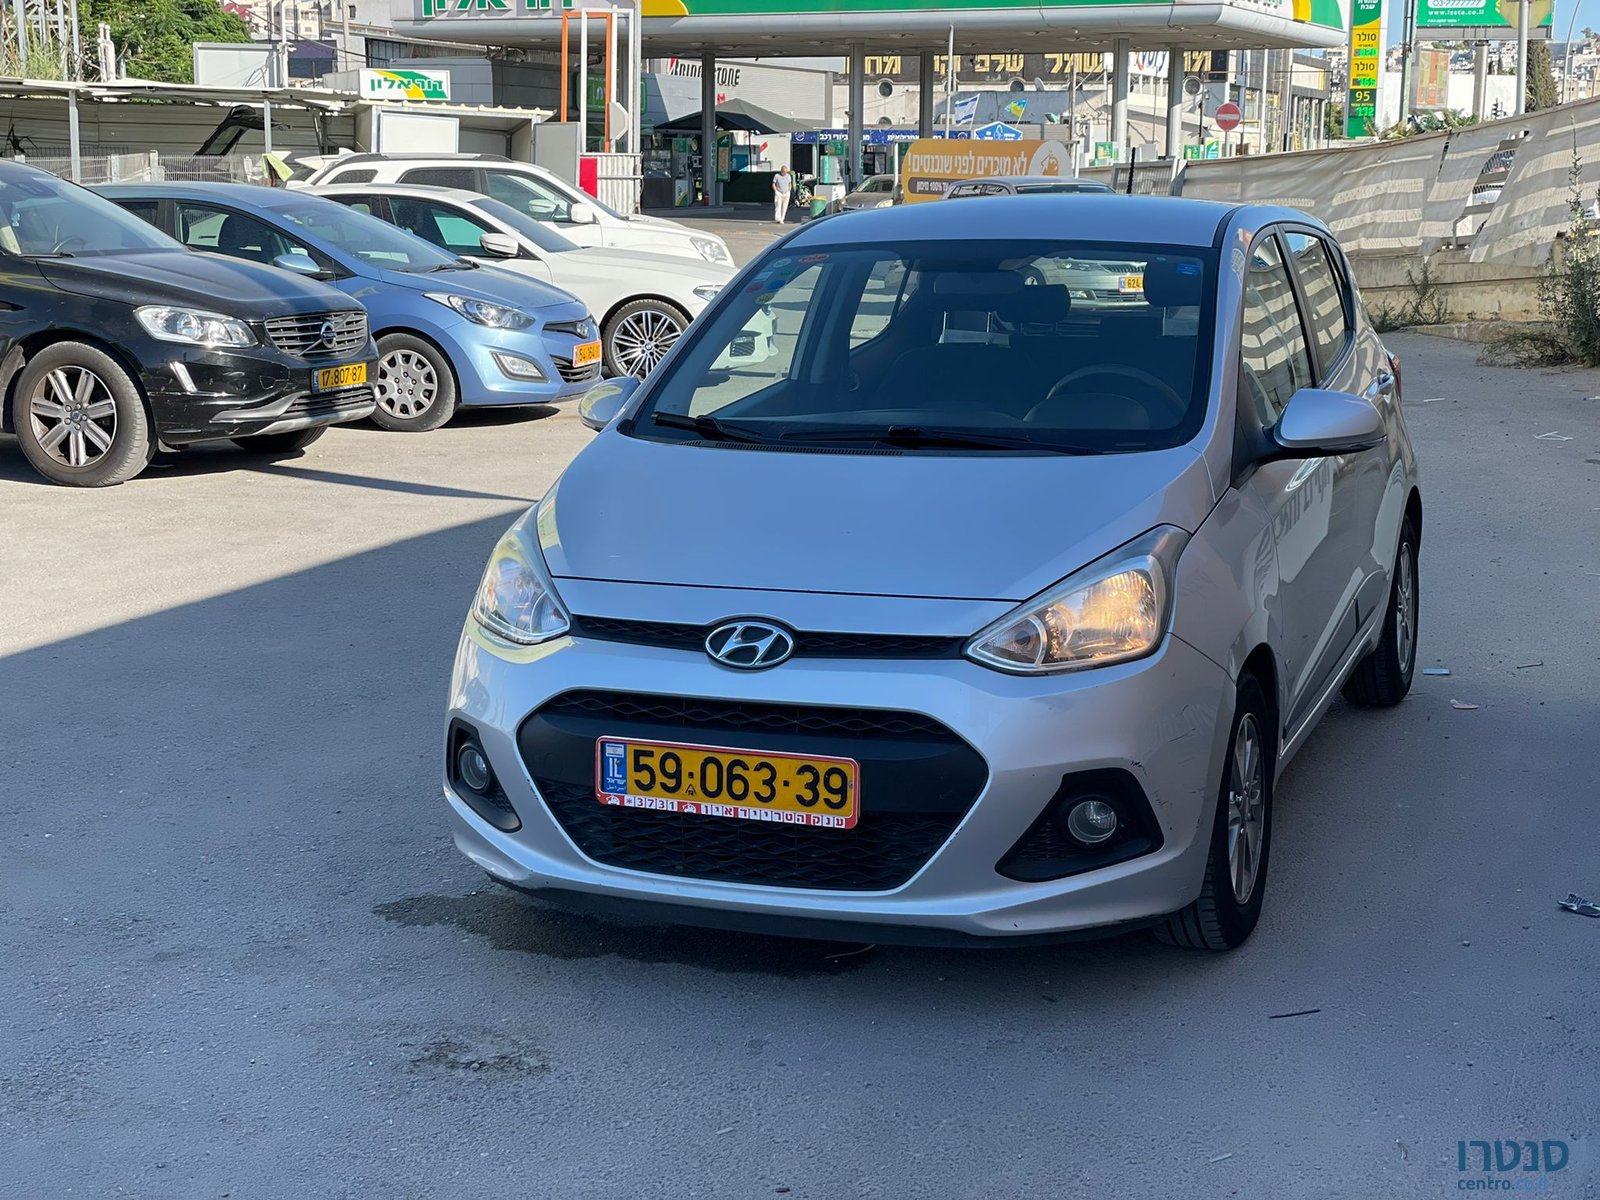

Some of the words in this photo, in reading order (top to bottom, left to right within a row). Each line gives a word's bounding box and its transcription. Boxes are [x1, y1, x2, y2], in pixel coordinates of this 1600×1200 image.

[1356, 32, 1377, 42] סולר
[1354, 61, 1375, 71] סולר
[370, 77, 412, 92] אלון
[415, 79, 443, 90] דור
[1355, 91, 1370, 102] 95
[954, 150, 975, 175] לפני
[1012, 151, 1028, 176] לא
[608, 757, 623, 778] IL
[703, 804, 734, 816] אין
[740, 808, 805, 824] הטרייד
[811, 816, 844, 827] ענק
